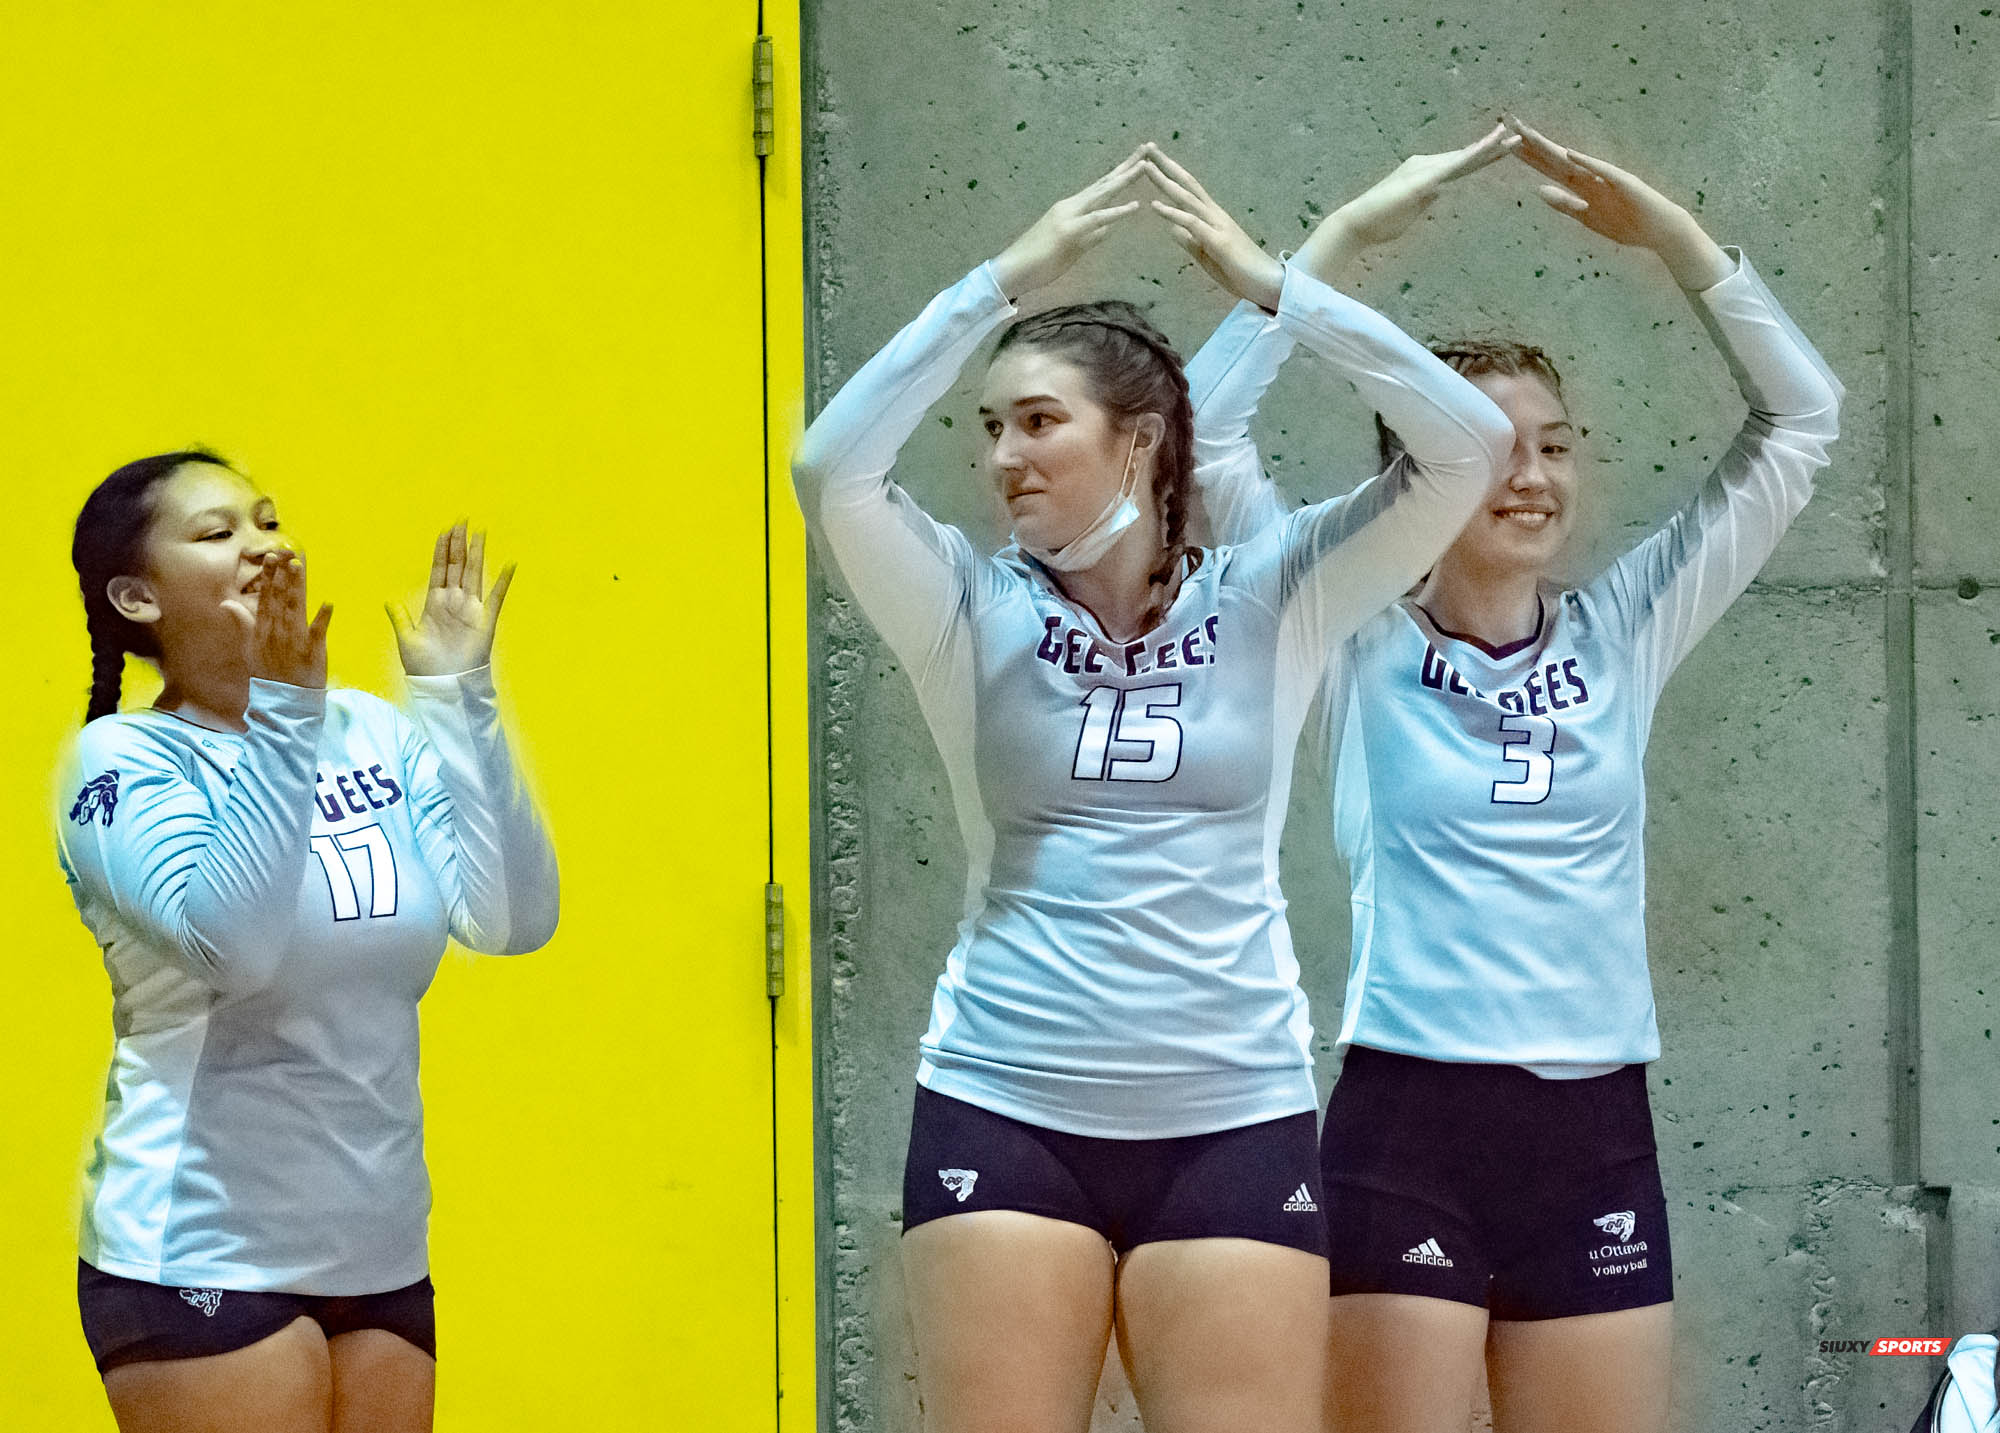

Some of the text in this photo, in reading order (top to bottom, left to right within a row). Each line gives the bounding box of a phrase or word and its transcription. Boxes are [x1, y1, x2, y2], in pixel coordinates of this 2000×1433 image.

[1071, 682, 1183, 783] 15
[1491, 714, 1558, 805] 3
[310, 823, 398, 922] 17
[1283, 1201, 1318, 1212] adidas
[1402, 1252, 1454, 1268] adidas
[1592, 1258, 1648, 1277] Volleyball
